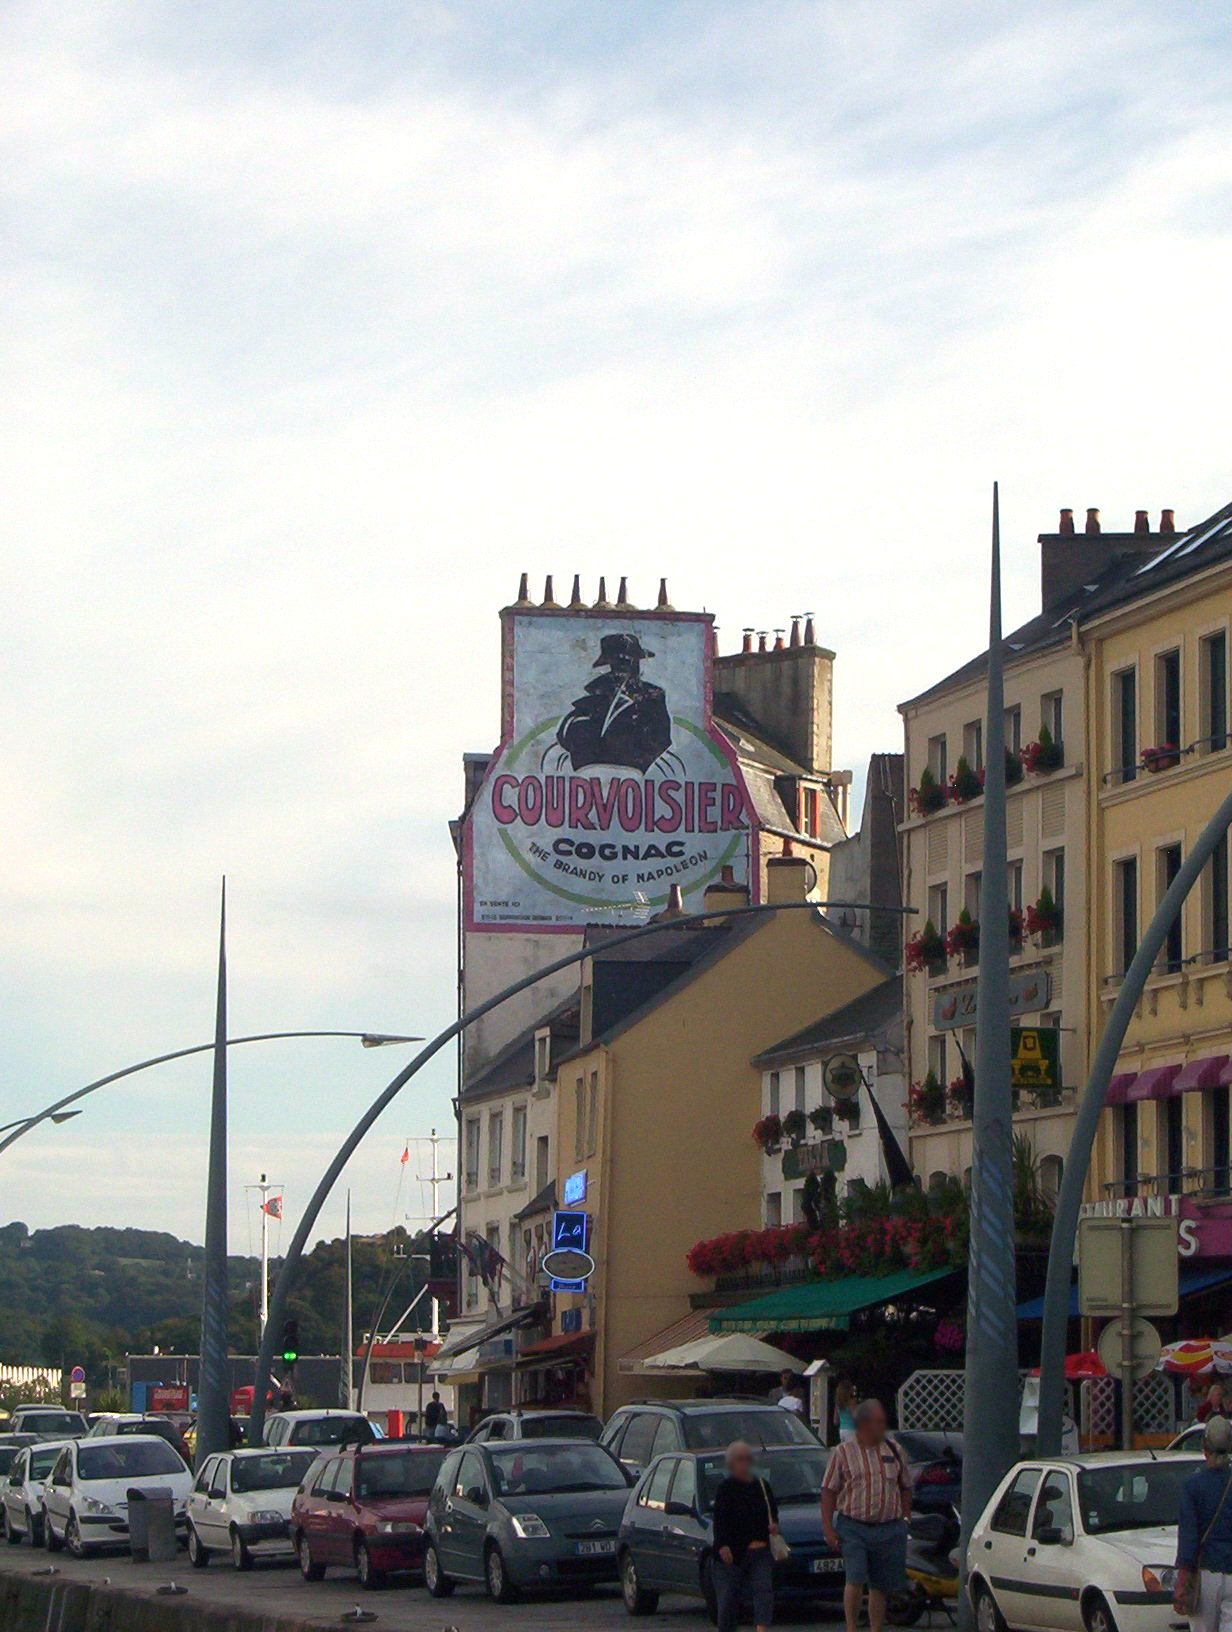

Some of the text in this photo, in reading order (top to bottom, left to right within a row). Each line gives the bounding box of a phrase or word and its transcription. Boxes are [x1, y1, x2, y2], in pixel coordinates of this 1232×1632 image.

[491, 774, 750, 833] COURVOISIER
[527, 841, 709, 884] THE BRANDY OF NAPOLEON
[552, 837, 688, 861] COGNAC
